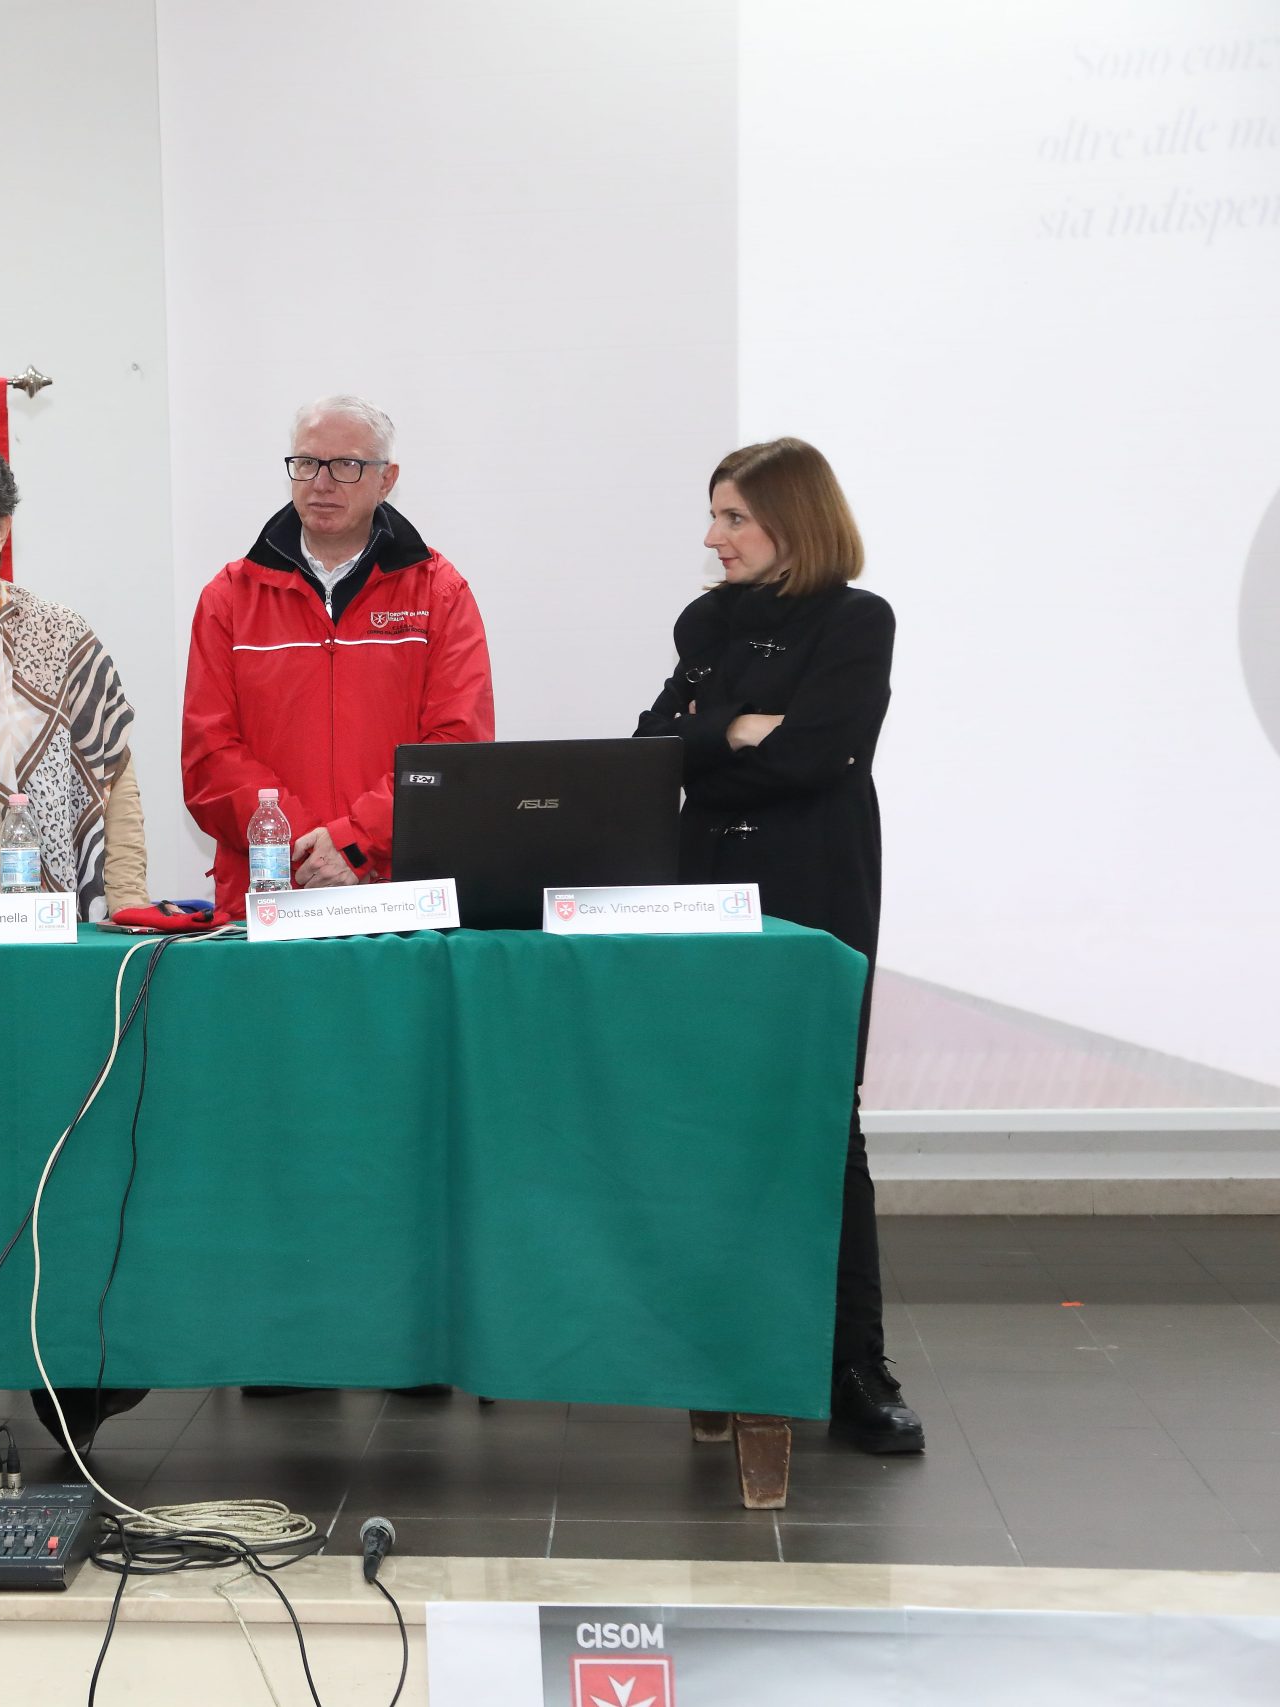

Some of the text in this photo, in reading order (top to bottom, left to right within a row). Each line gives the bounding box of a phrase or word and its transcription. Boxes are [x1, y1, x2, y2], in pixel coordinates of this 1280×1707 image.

[1037, 115, 1134, 162] oltre
[1141, 106, 1218, 156] alle
[1035, 195, 1096, 240] sia
[517, 798, 560, 810] ASUS
[278, 901, 415, 919] Dott.ssa Valentina Territo
[579, 901, 716, 914] Cav. Vincenzo Profita
[576, 1623, 664, 1649] CISOM
